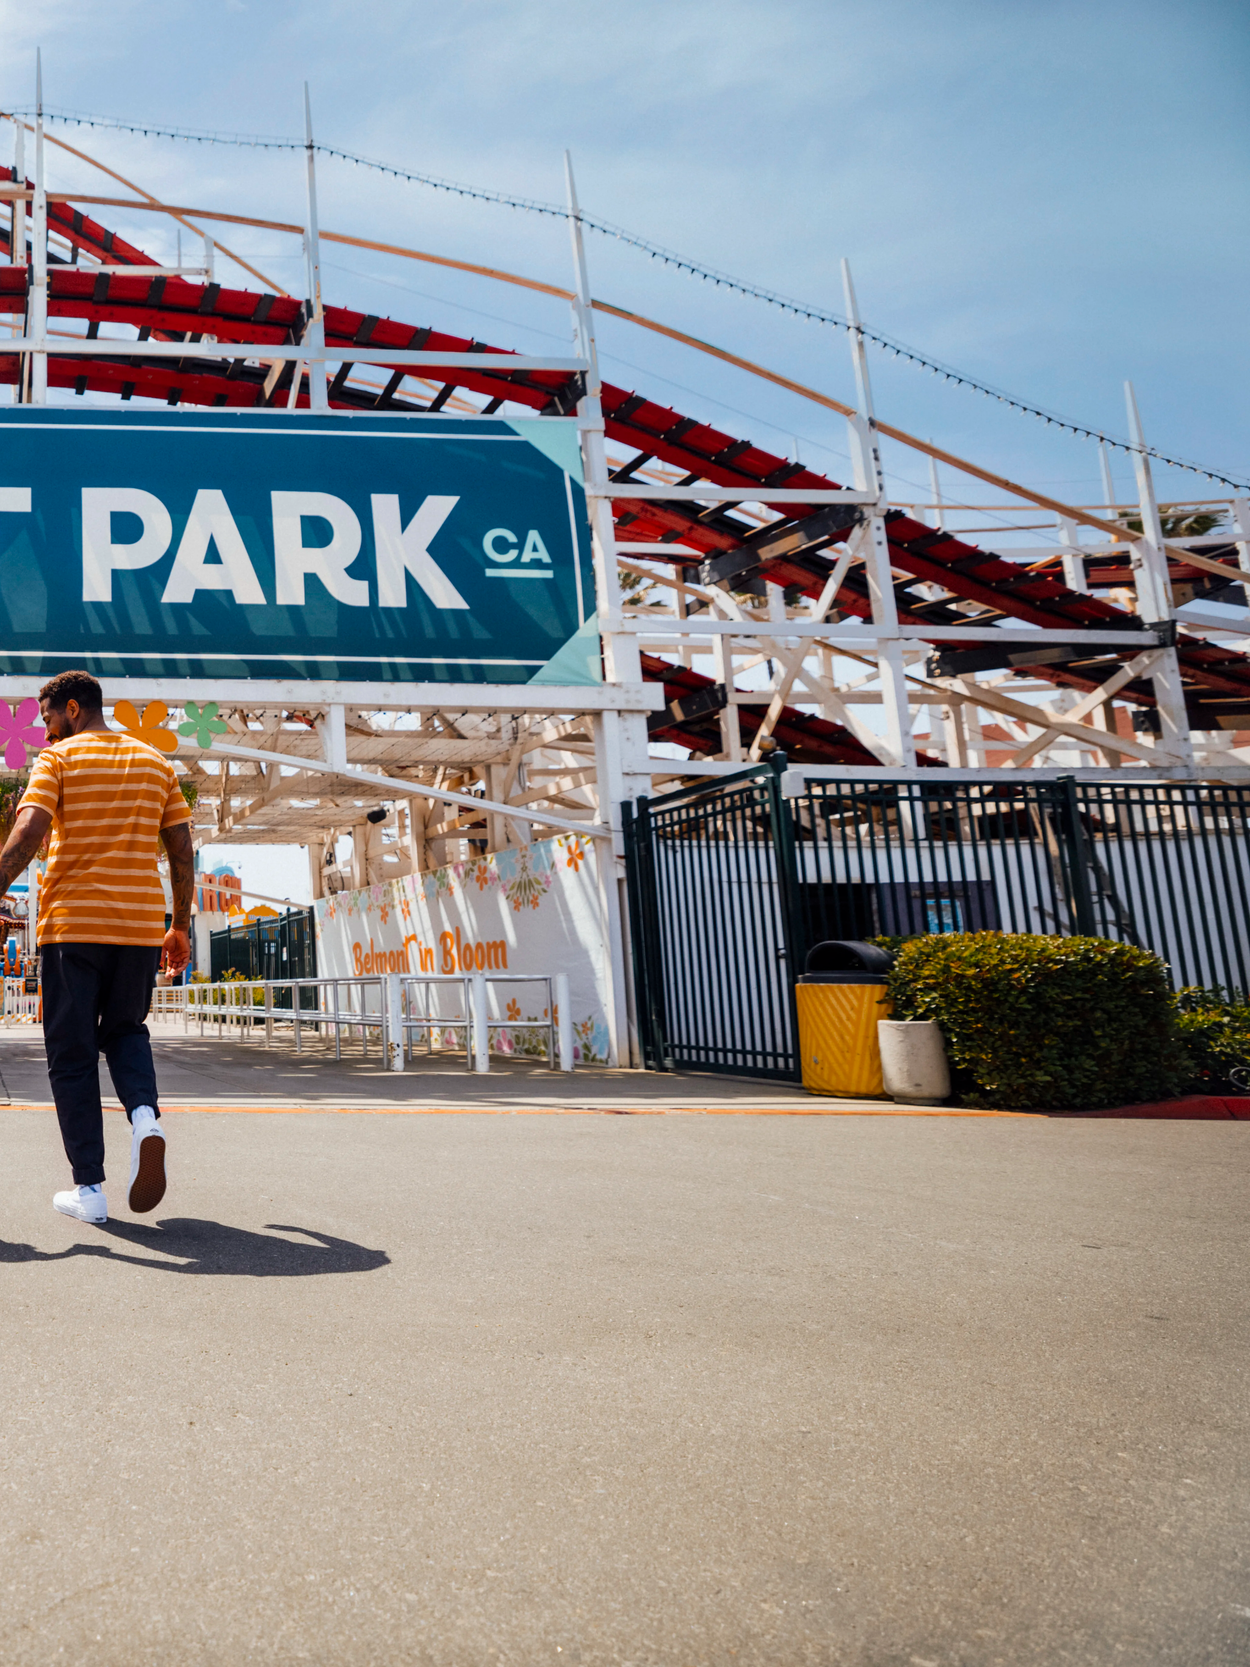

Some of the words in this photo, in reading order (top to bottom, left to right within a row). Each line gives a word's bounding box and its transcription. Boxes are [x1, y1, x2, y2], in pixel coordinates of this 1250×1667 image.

[81, 487, 470, 610] PARK
[482, 527, 552, 564] CA
[352, 933, 417, 976] Belmont
[418, 940, 435, 973] in
[439, 926, 508, 975] Bloom
